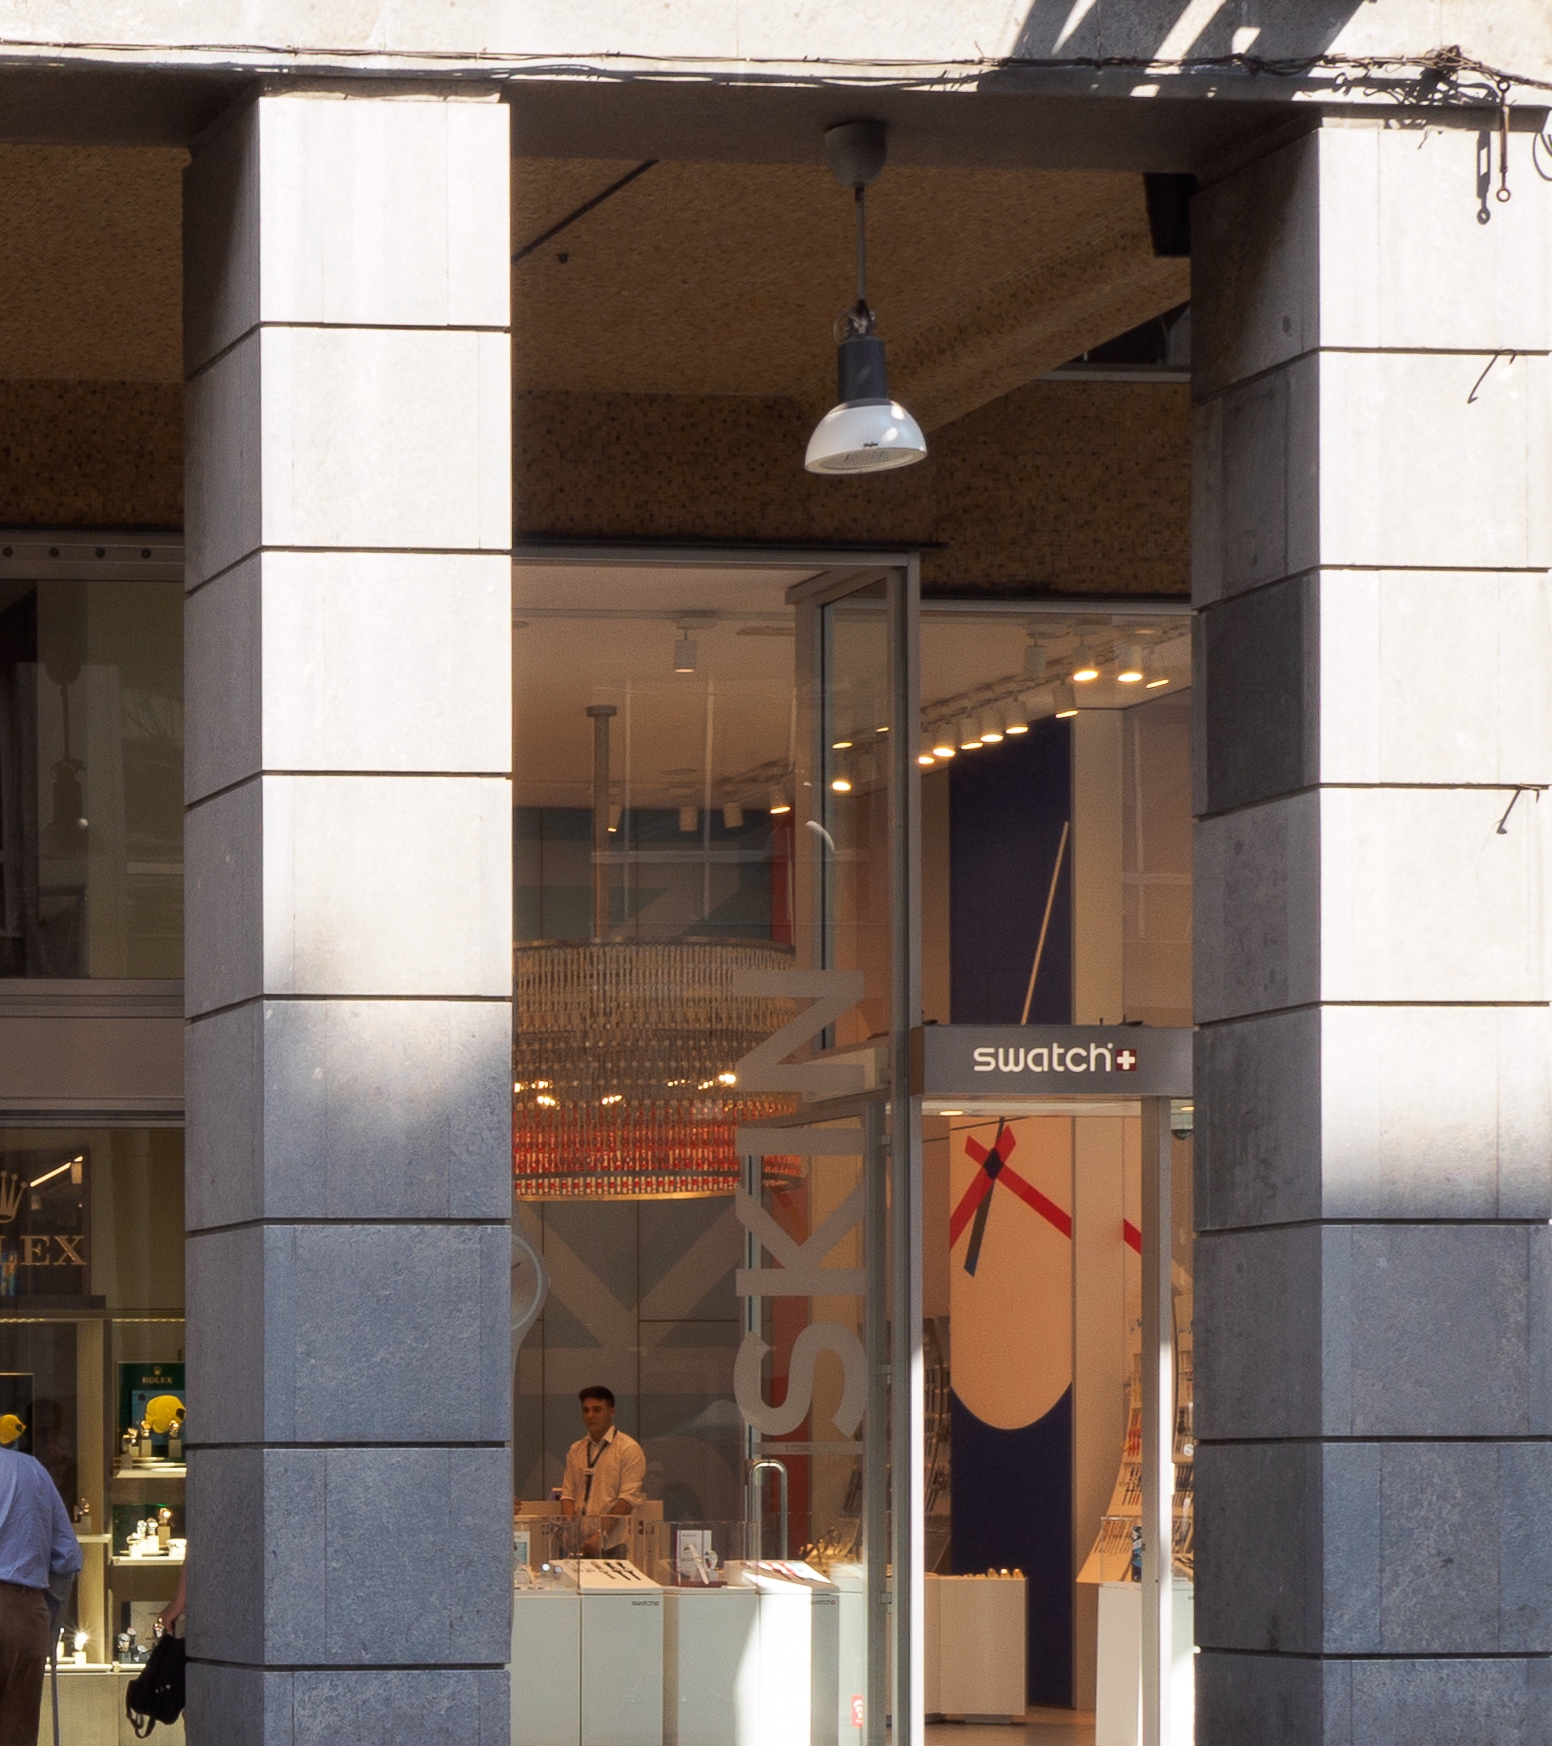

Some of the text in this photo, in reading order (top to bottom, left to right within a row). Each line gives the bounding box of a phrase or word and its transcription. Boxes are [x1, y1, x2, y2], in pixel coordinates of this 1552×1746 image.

[972, 1041, 1114, 1074] swatch
[733, 969, 869, 1439] SKIN
[141, 1376, 173, 1385] ROLEX
